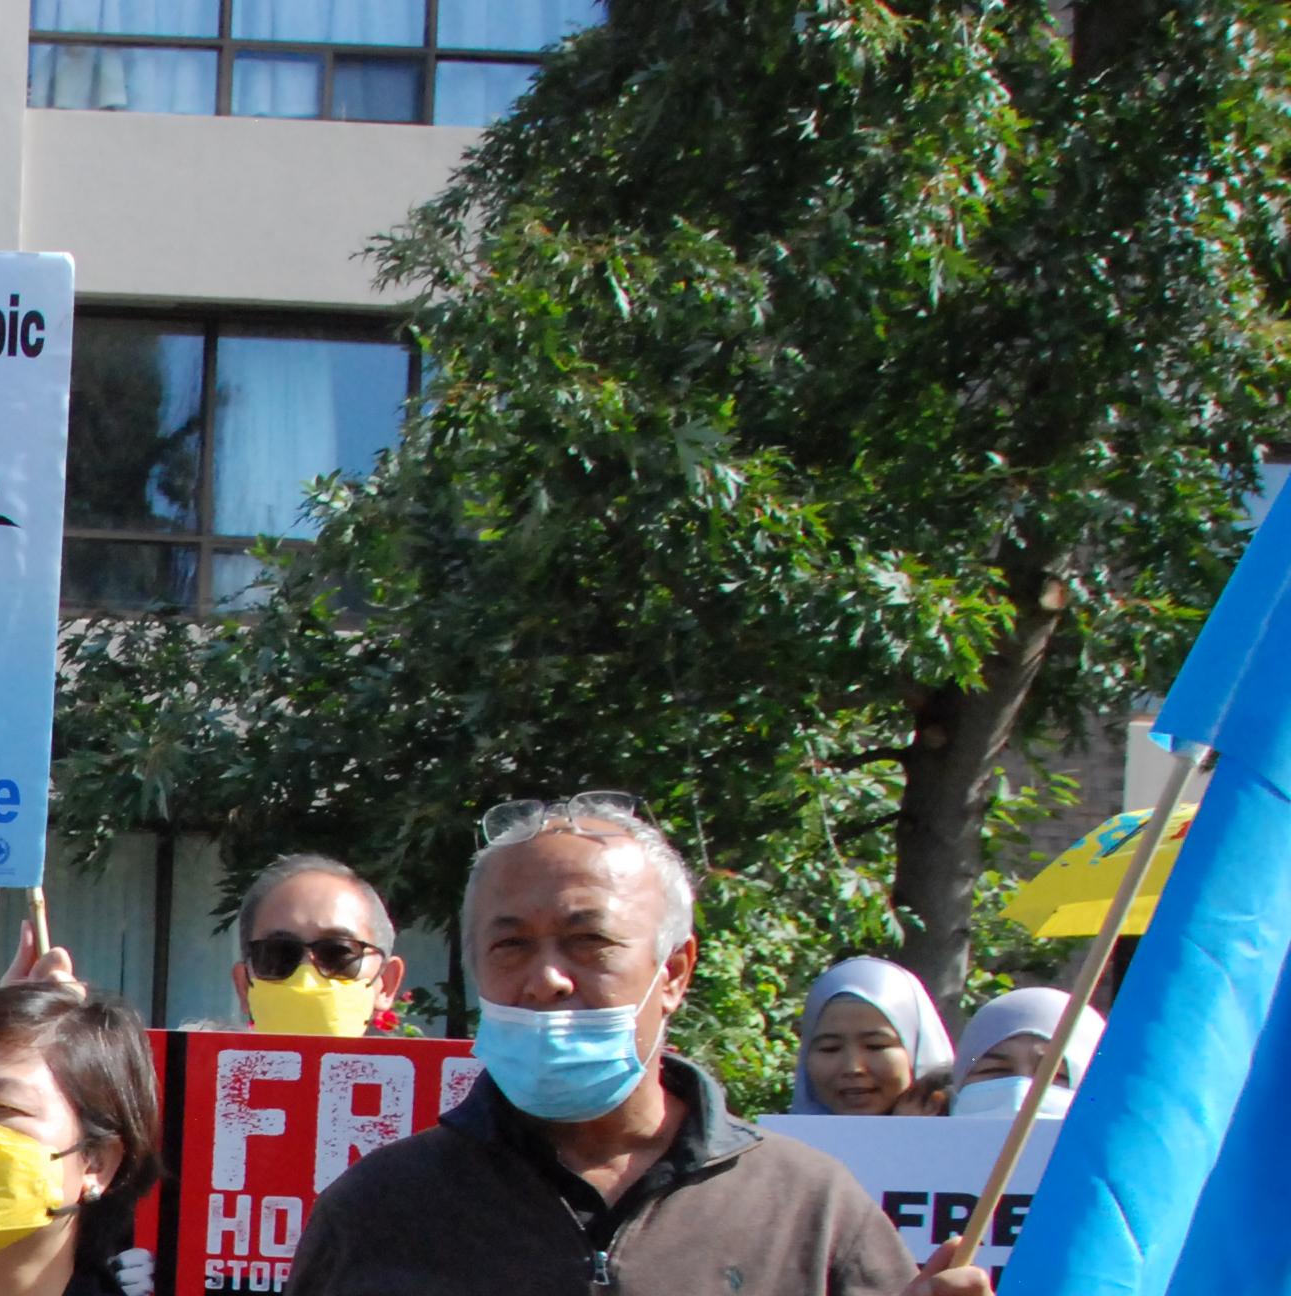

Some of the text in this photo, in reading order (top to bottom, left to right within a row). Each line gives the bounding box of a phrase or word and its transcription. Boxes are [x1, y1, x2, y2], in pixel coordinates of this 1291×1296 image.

[211, 1049, 485, 1195] FR
[882, 1191, 1034, 1247] FRE
[205, 1259, 292, 1293] STOP
